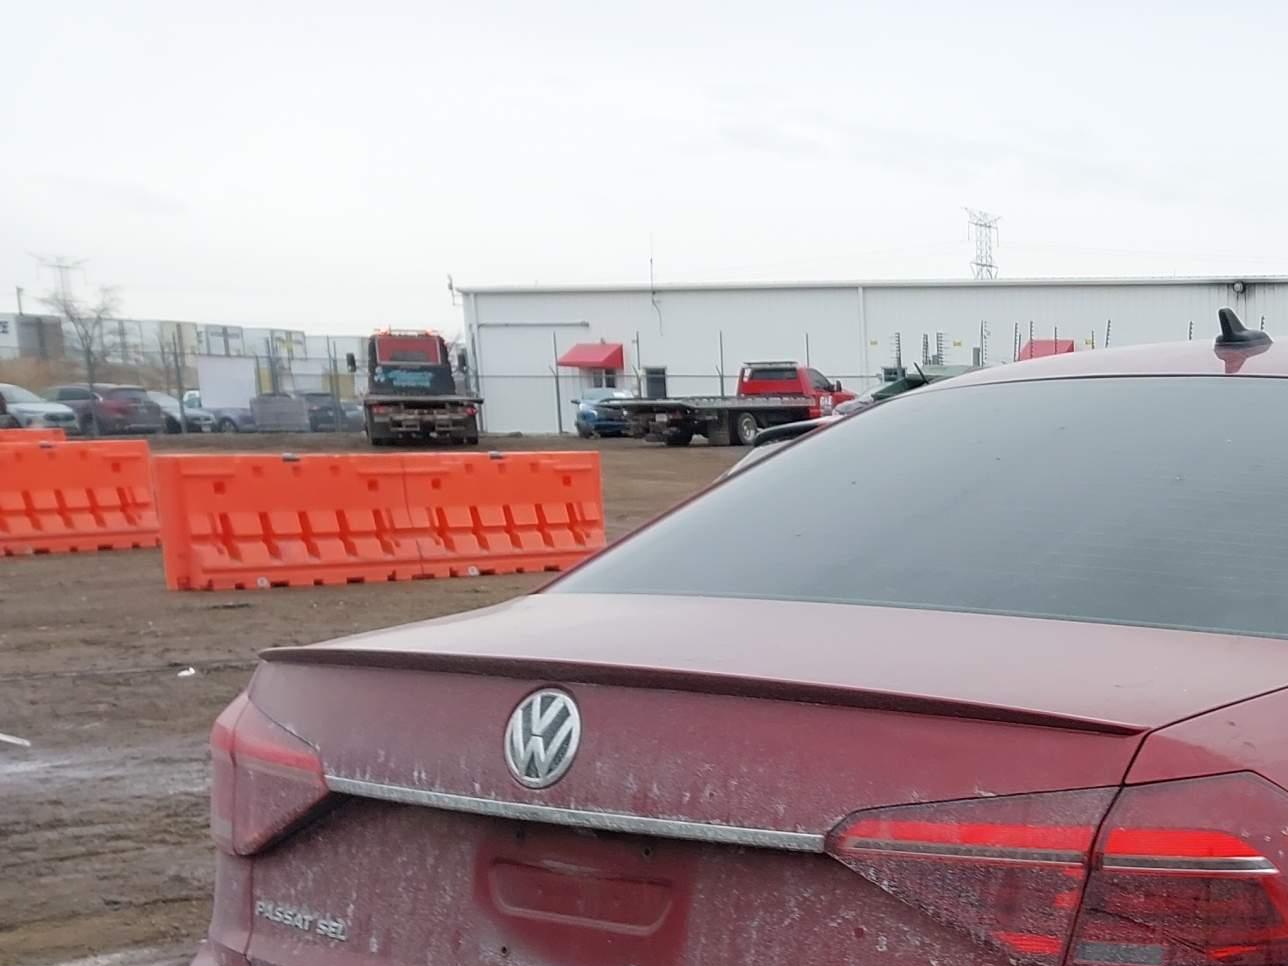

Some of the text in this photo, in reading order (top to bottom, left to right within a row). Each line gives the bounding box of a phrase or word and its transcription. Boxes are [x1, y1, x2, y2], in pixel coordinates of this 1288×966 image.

[508, 690, 578, 783] VW
[255, 900, 346, 941] PASSAT SEL
